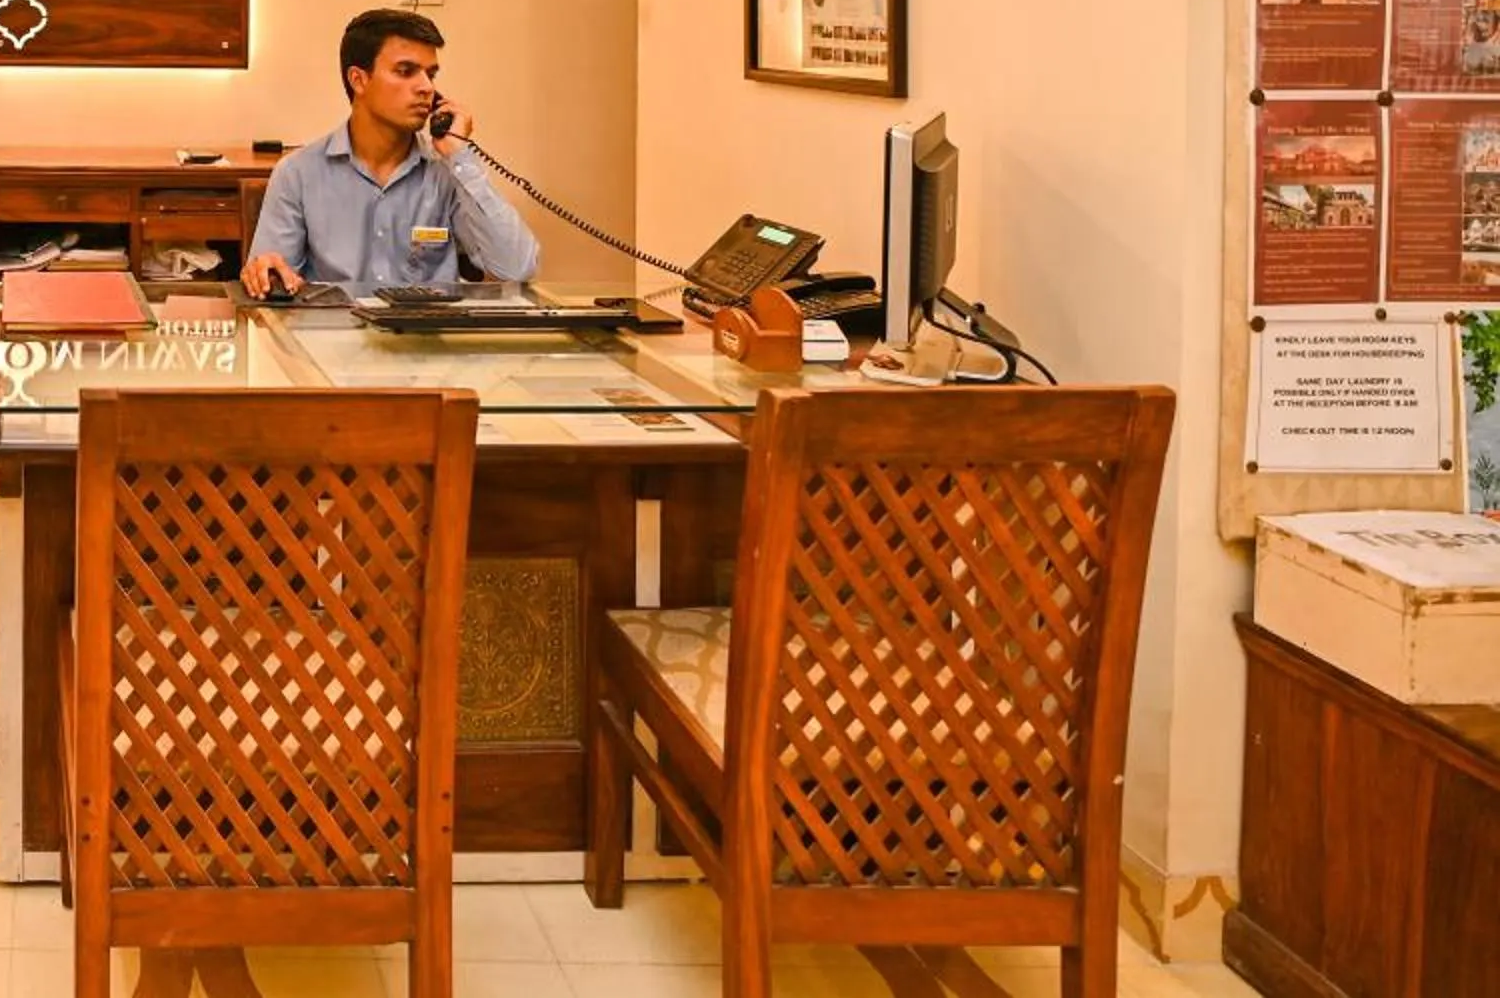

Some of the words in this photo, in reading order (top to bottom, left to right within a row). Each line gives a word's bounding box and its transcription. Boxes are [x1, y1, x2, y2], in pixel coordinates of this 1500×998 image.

[1275, 336, 1306, 344] KINDLY
[1307, 336, 1335, 344] LEAVE
[1337, 336, 1361, 344] YOUR
[1362, 336, 1389, 344] ROOM
[1390, 336, 1417, 344] KEYS
[1276, 350, 1288, 358] AT
[1290, 350, 1306, 358] THE
[1296, 377, 1322, 386] SAME
[1325, 377, 1345, 386] DAY
[1347, 377, 1391, 386] LAUNDRY
[1393, 377, 1403, 386] IS
[1273, 389, 1317, 397] POSSIBLE
[1318, 389, 1343, 397] ONLY
[1351, 389, 1388, 397] HANDED
[1389, 389, 1416, 397] OVER
[1281, 427, 1315, 435] CHECK
[1339, 427, 1359, 435] TIME
[1360, 427, 1369, 435] IS
[1371, 427, 1383, 435] 12
[1384, 427, 1416, 435] NOON
